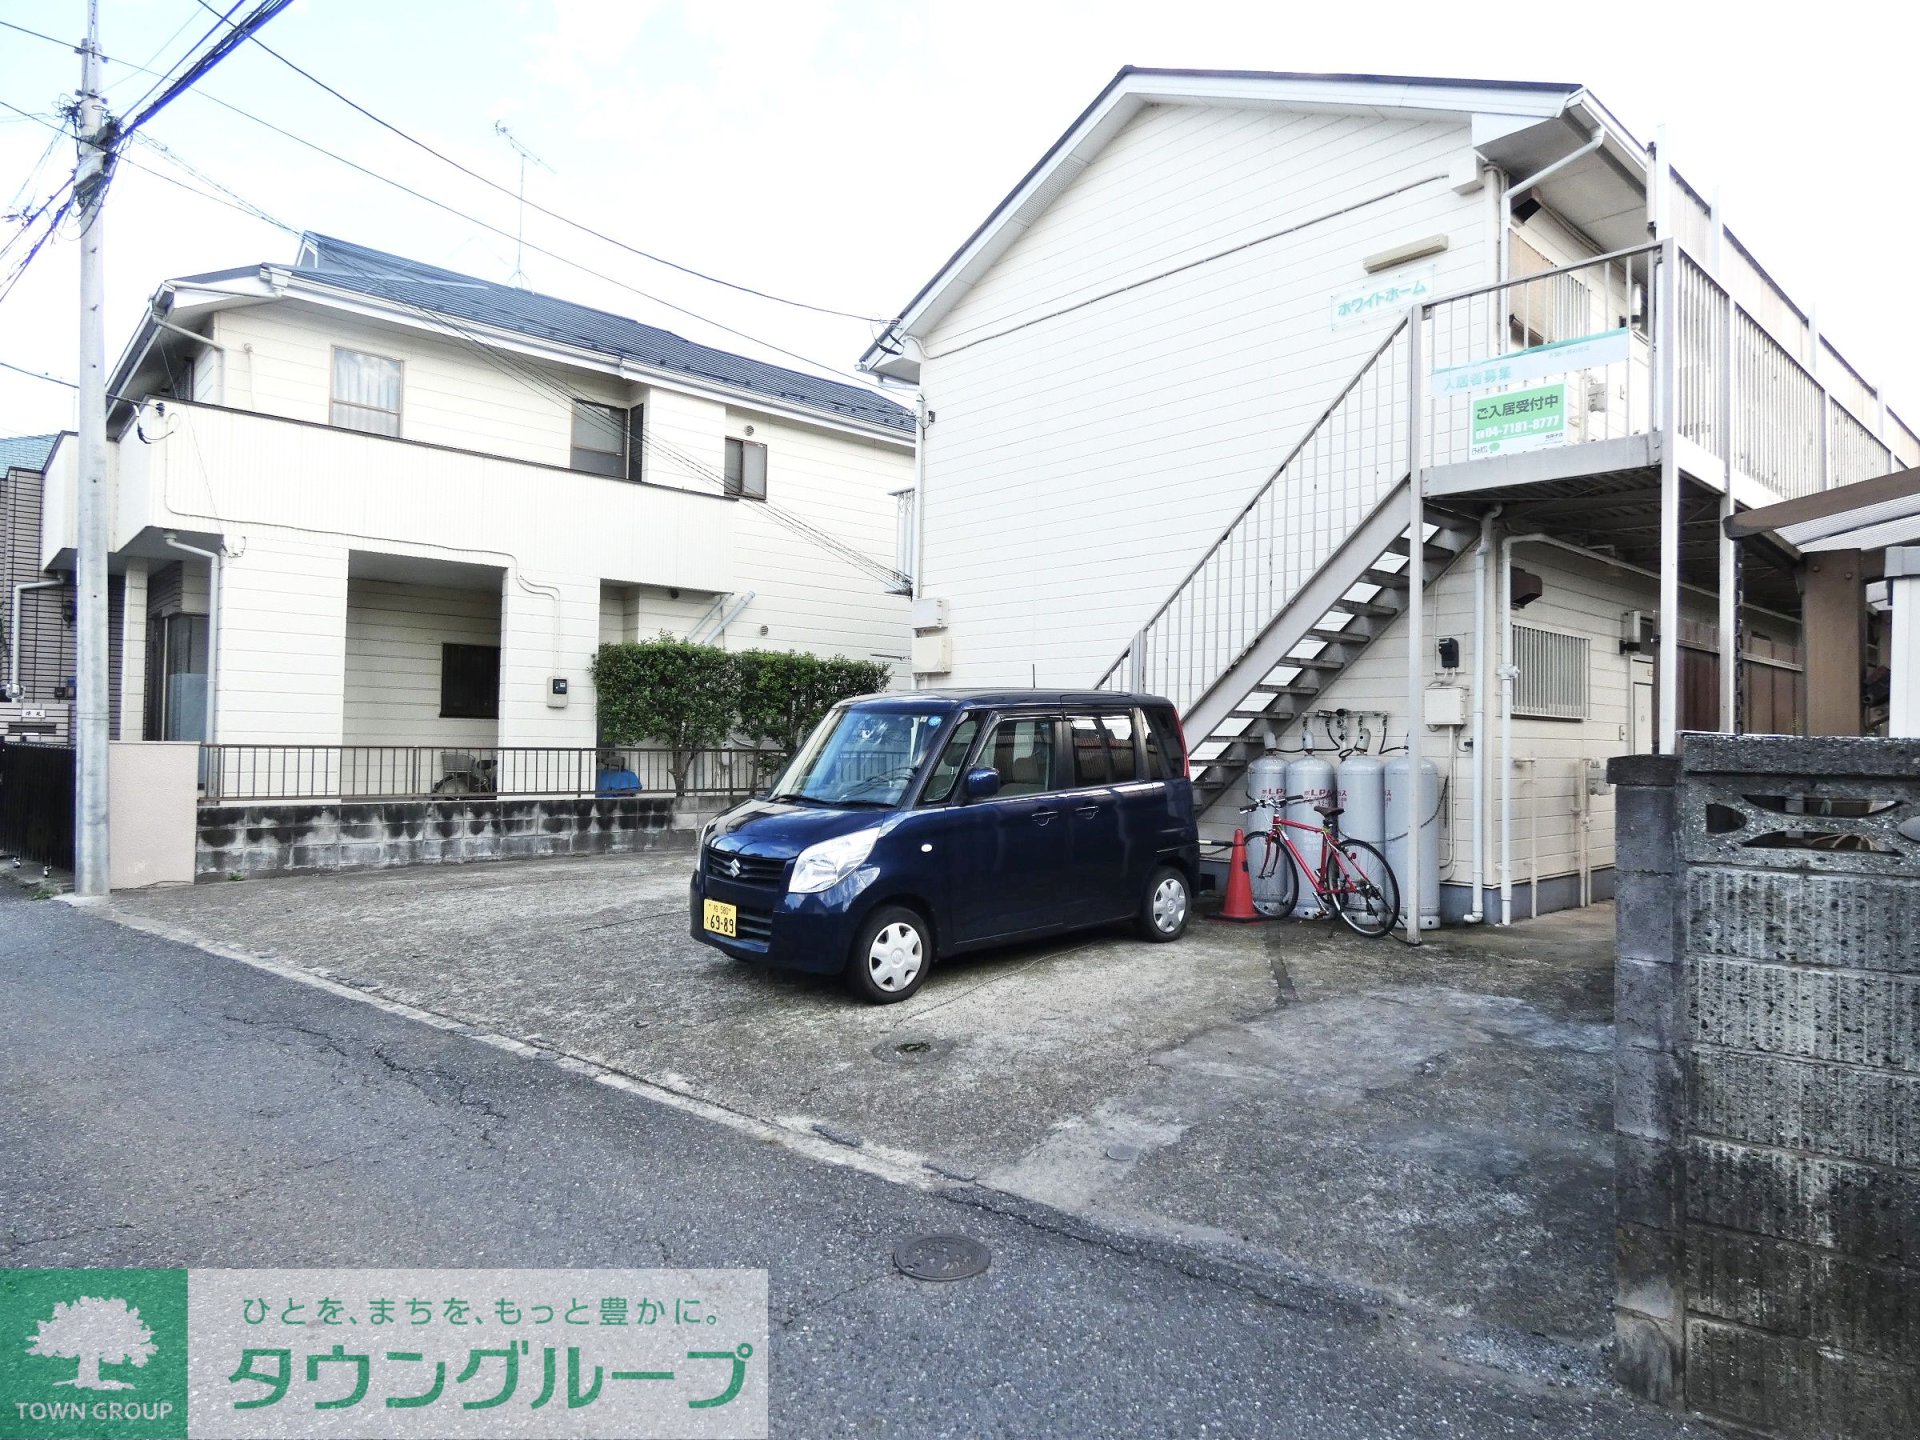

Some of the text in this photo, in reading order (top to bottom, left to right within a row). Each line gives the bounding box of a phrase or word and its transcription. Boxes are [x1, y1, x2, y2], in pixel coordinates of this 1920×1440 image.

[1338, 280, 1426, 316] ホワイトホーム
[1476, 394, 1559, 421] ご入居受付中
